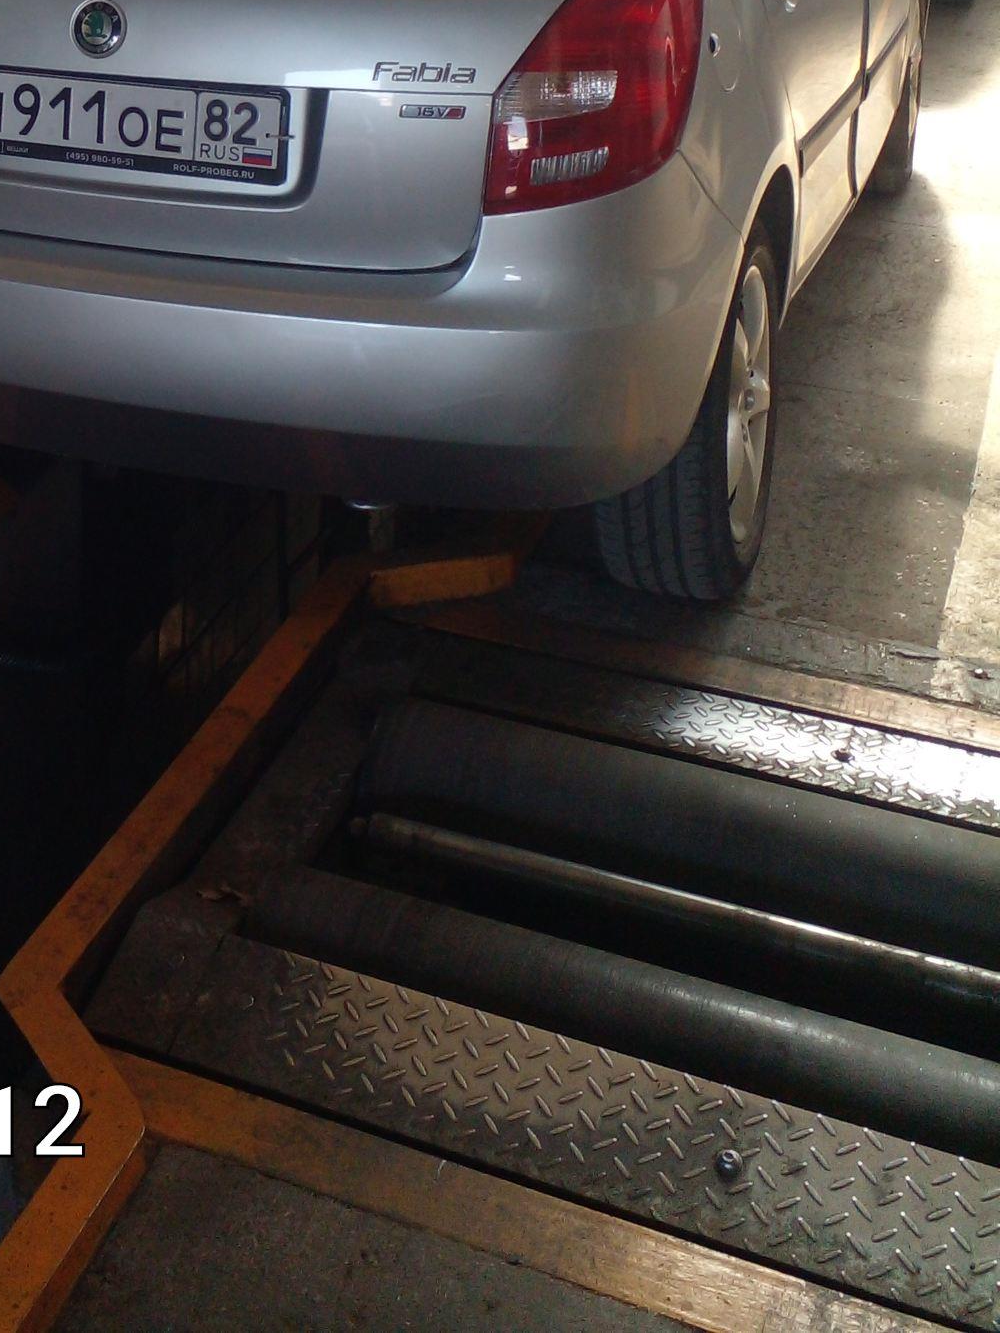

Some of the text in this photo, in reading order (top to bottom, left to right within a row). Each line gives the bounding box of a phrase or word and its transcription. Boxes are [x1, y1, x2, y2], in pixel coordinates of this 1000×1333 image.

[372, 61, 477, 84] Fabia
[203, 98, 259, 147] 82
[65, 151, 90, 163] (495)
[199, 142, 240, 162] RUS
[172, 163, 256, 180] ROLF-PROBEG.RU
